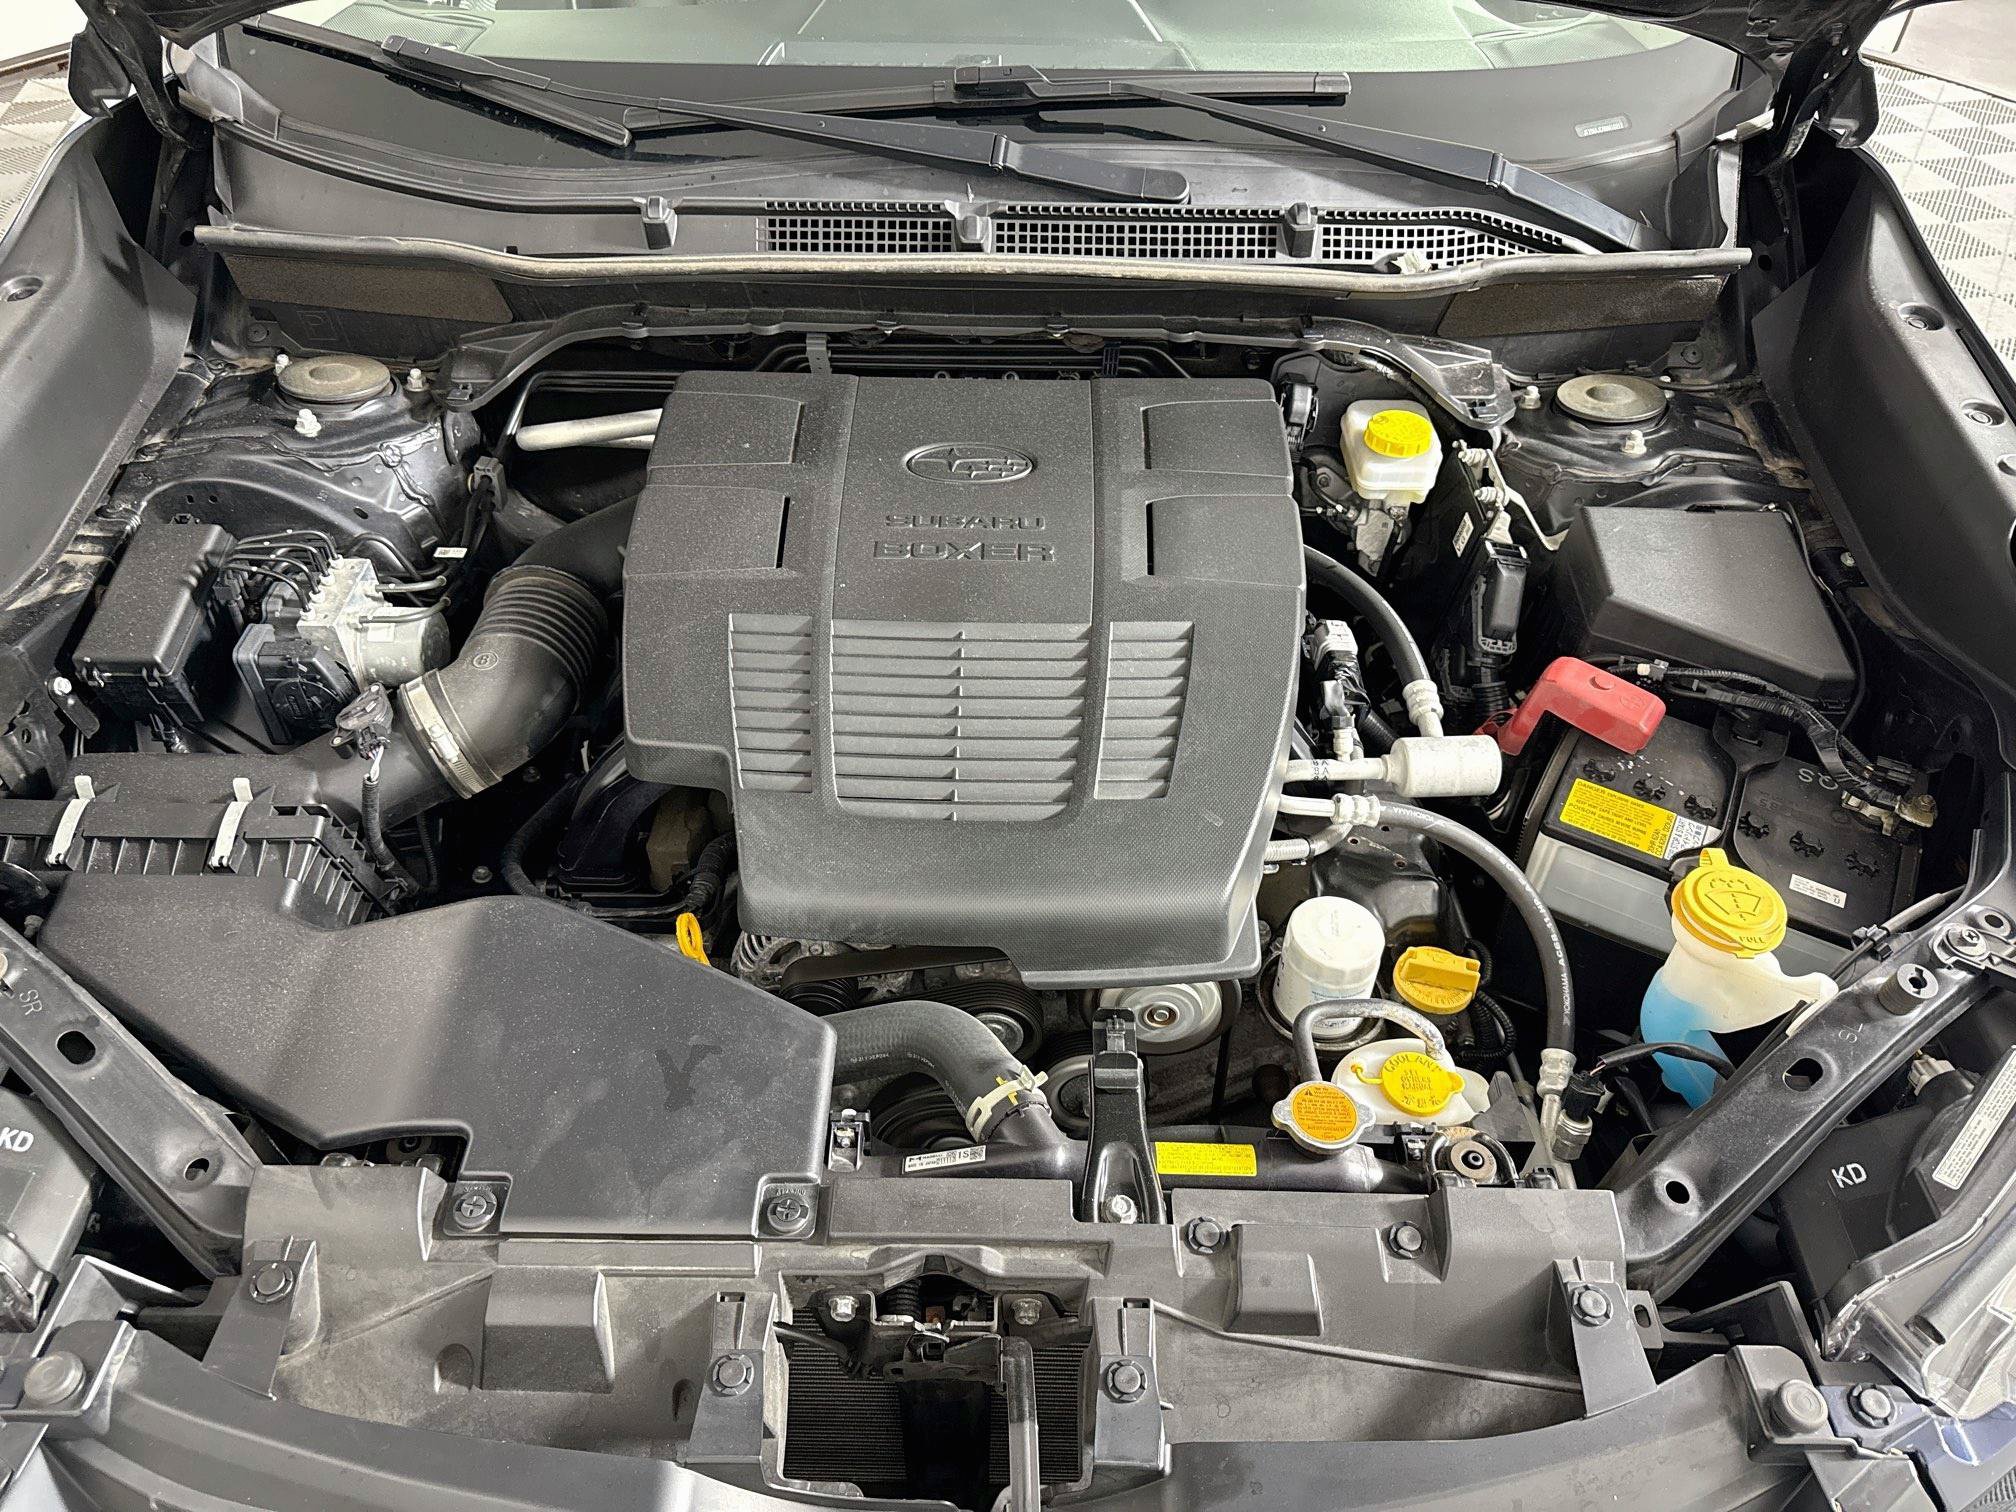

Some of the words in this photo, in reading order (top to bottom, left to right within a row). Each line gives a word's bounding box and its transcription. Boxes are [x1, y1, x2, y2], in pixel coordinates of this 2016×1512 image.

[885, 515, 1045, 529] SUBARU
[873, 541, 1055, 561] BOXER
[1577, 780, 1605, 794] DANGER
[1568, 802, 1597, 816] POISON
[1562, 972, 1573, 1012] YOKOHAMA
[19, 989, 43, 1016] SR
[1838, 1023, 1864, 1044] SL
[1384, 1053, 1442, 1073] COOLANT
[0, 1126, 34, 1152] KD
[1831, 1162, 1868, 1189] KD
